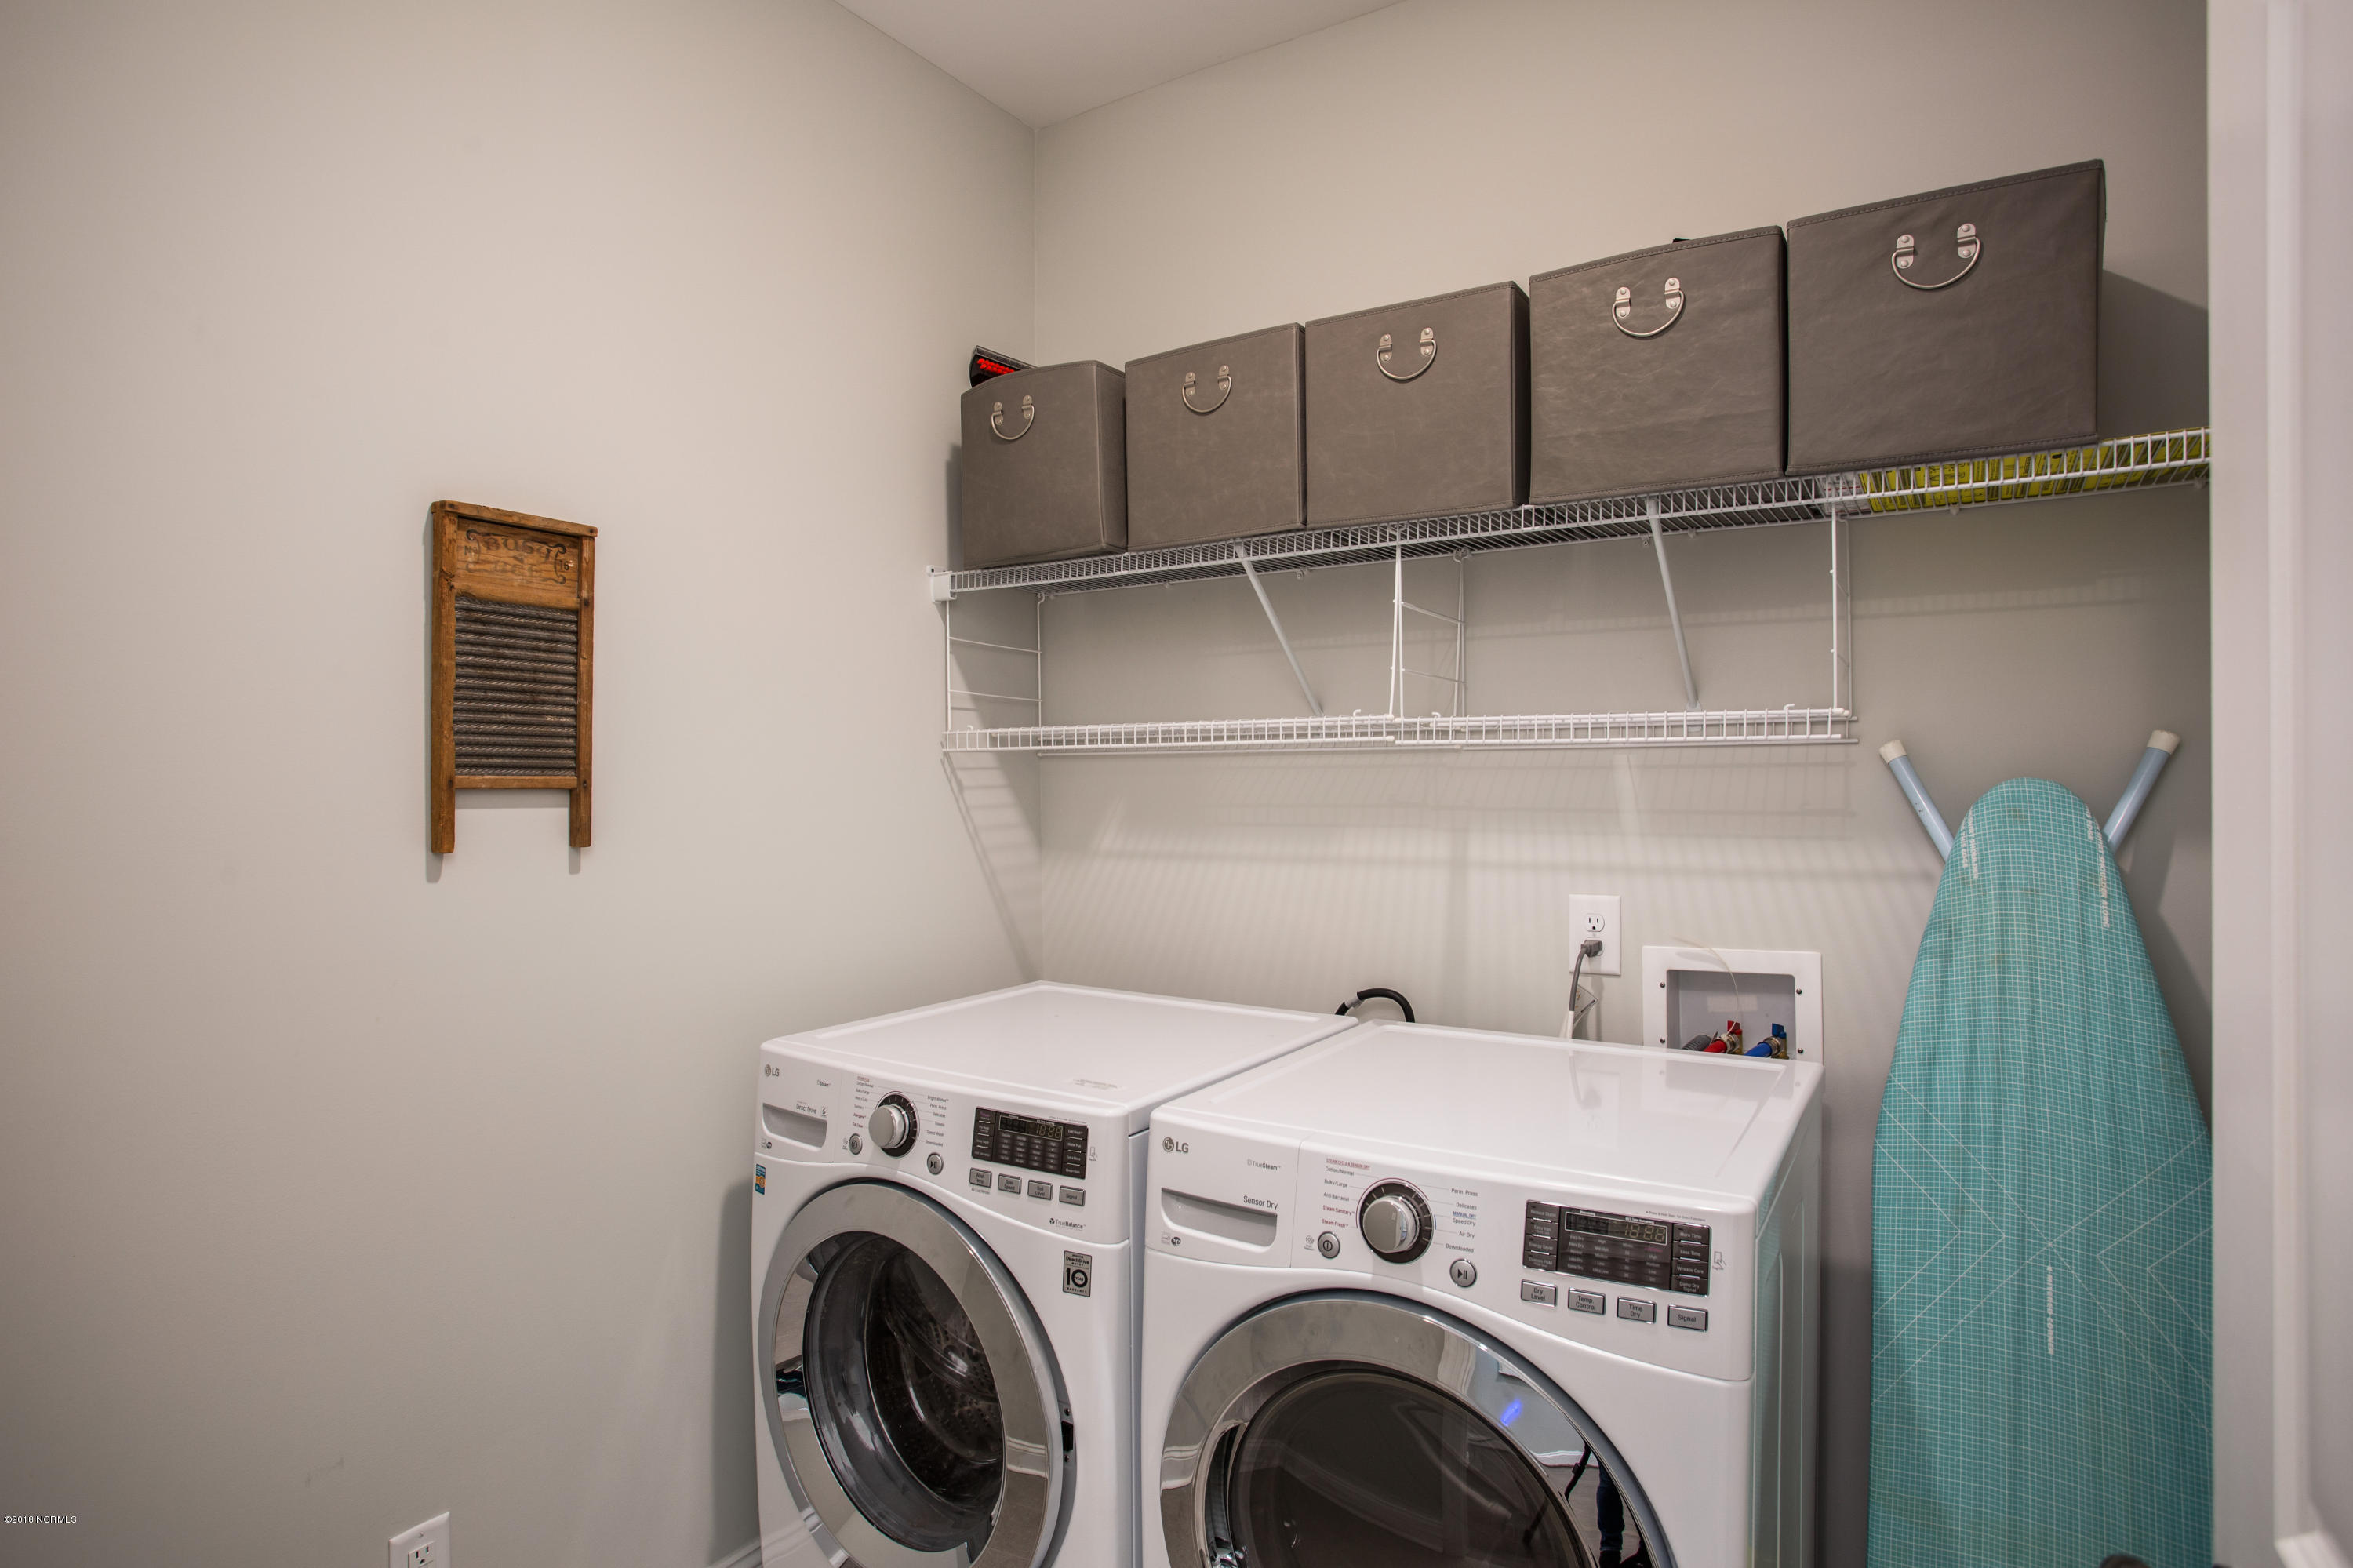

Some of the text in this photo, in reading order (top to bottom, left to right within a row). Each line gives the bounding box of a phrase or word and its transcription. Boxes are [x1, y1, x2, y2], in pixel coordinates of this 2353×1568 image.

[772, 1067, 780, 1077] LG
[1176, 1141, 1189, 1153] LG
[1243, 1195, 1278, 1210] Sensor Dry
[1456, 1202, 1477, 1210] Delicates
[1066, 1267, 1088, 1288] 10
[1577, 1295, 1594, 1304] Temp.
[1575, 1301, 1596, 1311] Control
[1677, 1314, 1697, 1322] Signal
